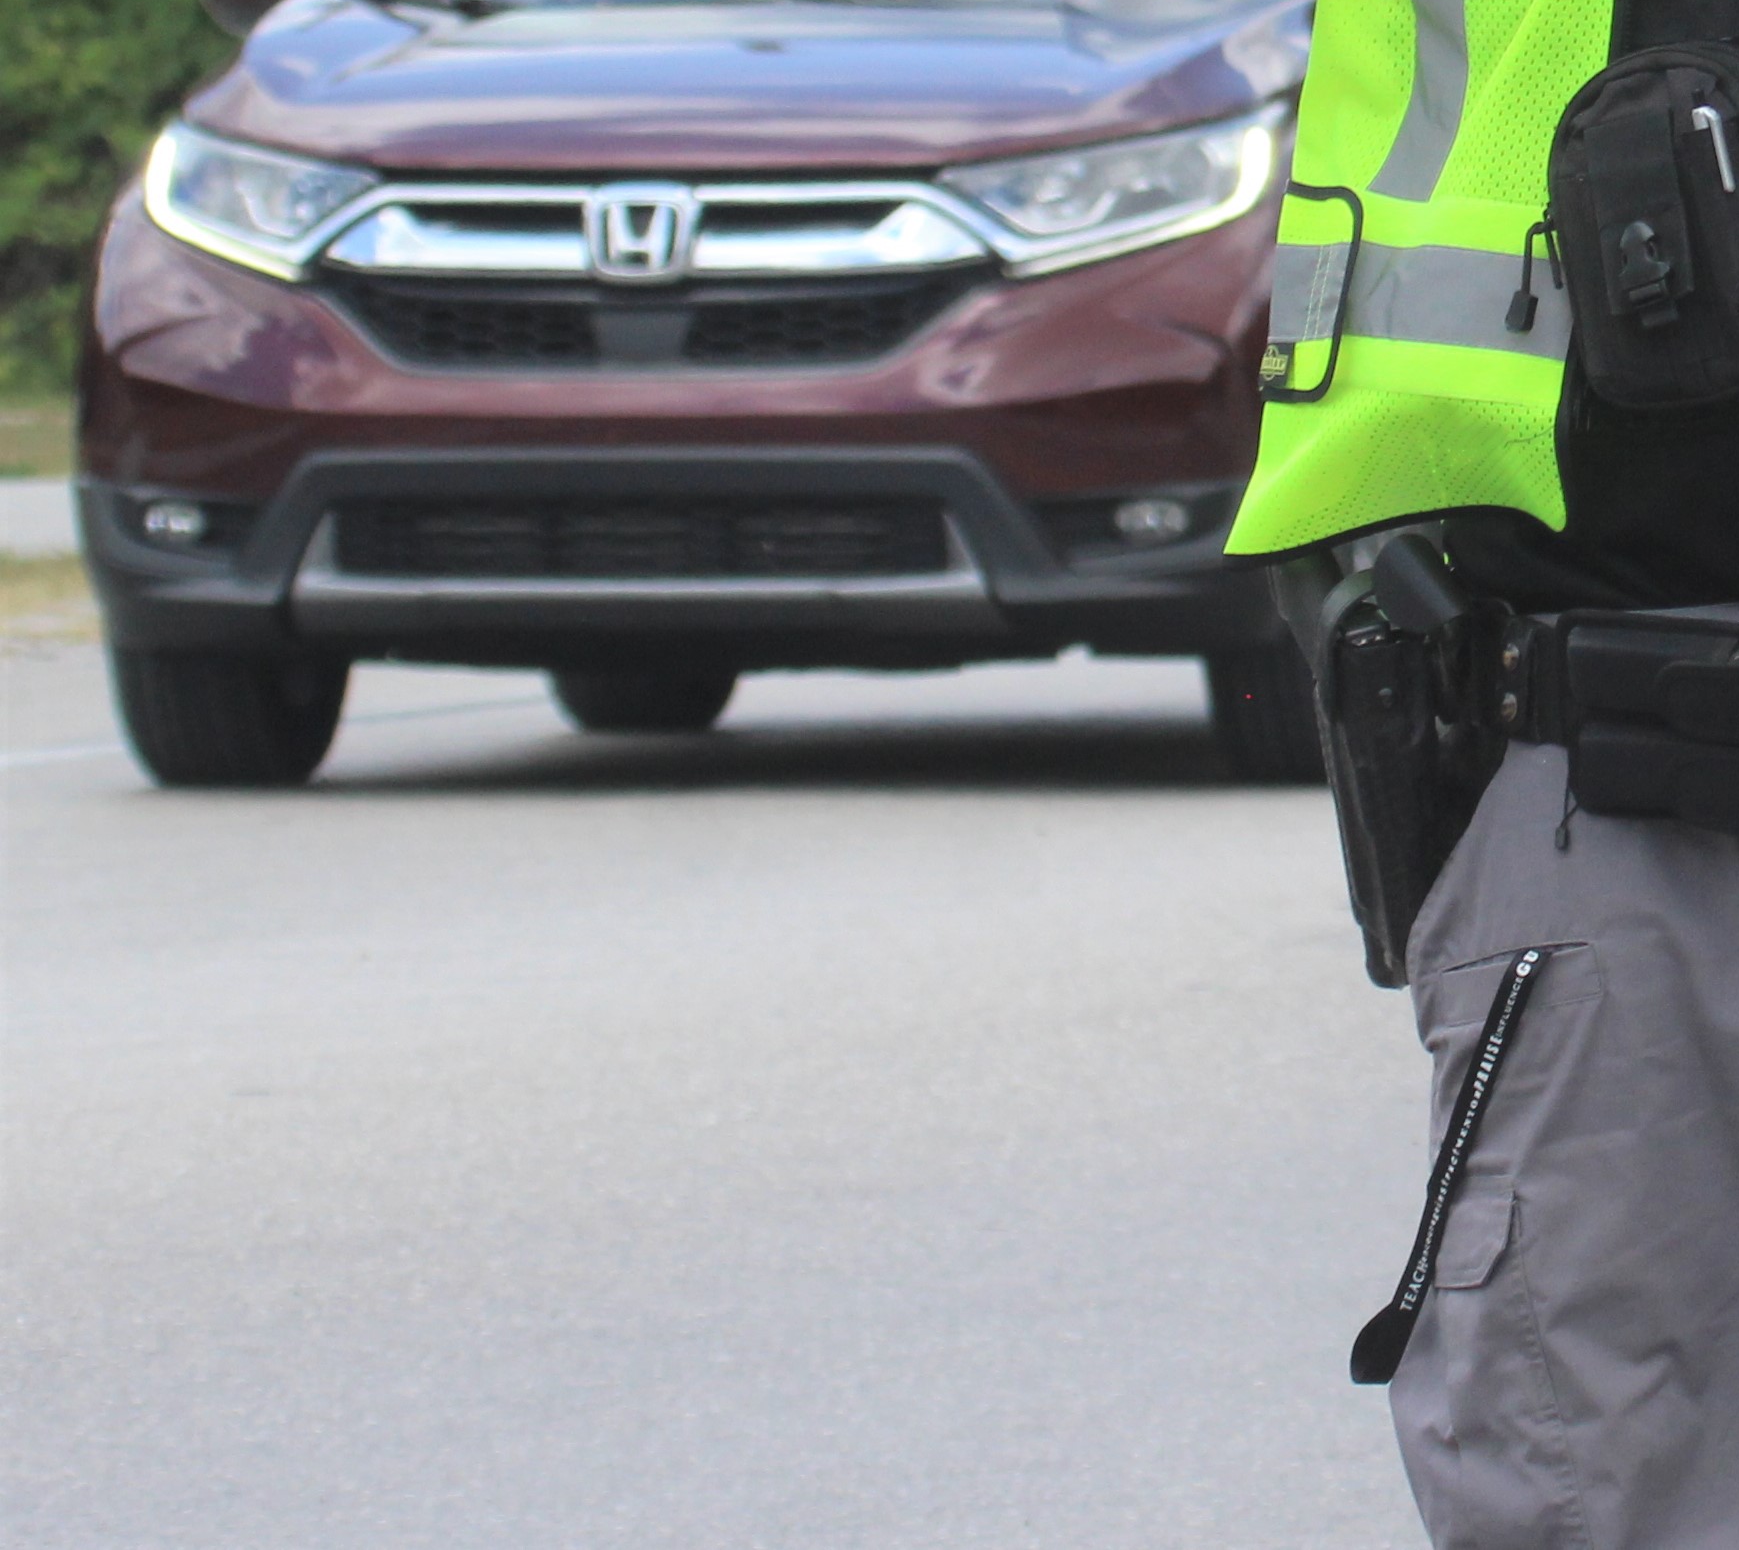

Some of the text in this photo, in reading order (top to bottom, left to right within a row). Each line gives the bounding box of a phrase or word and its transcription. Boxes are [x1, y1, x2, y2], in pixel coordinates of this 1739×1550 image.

[1399, 1259, 1429, 1312] TEACH
[1455, 1090, 1482, 1148] MENTOR
[1473, 1034, 1503, 1092] PRAISE
[1495, 977, 1524, 1037] INFLUENCE
